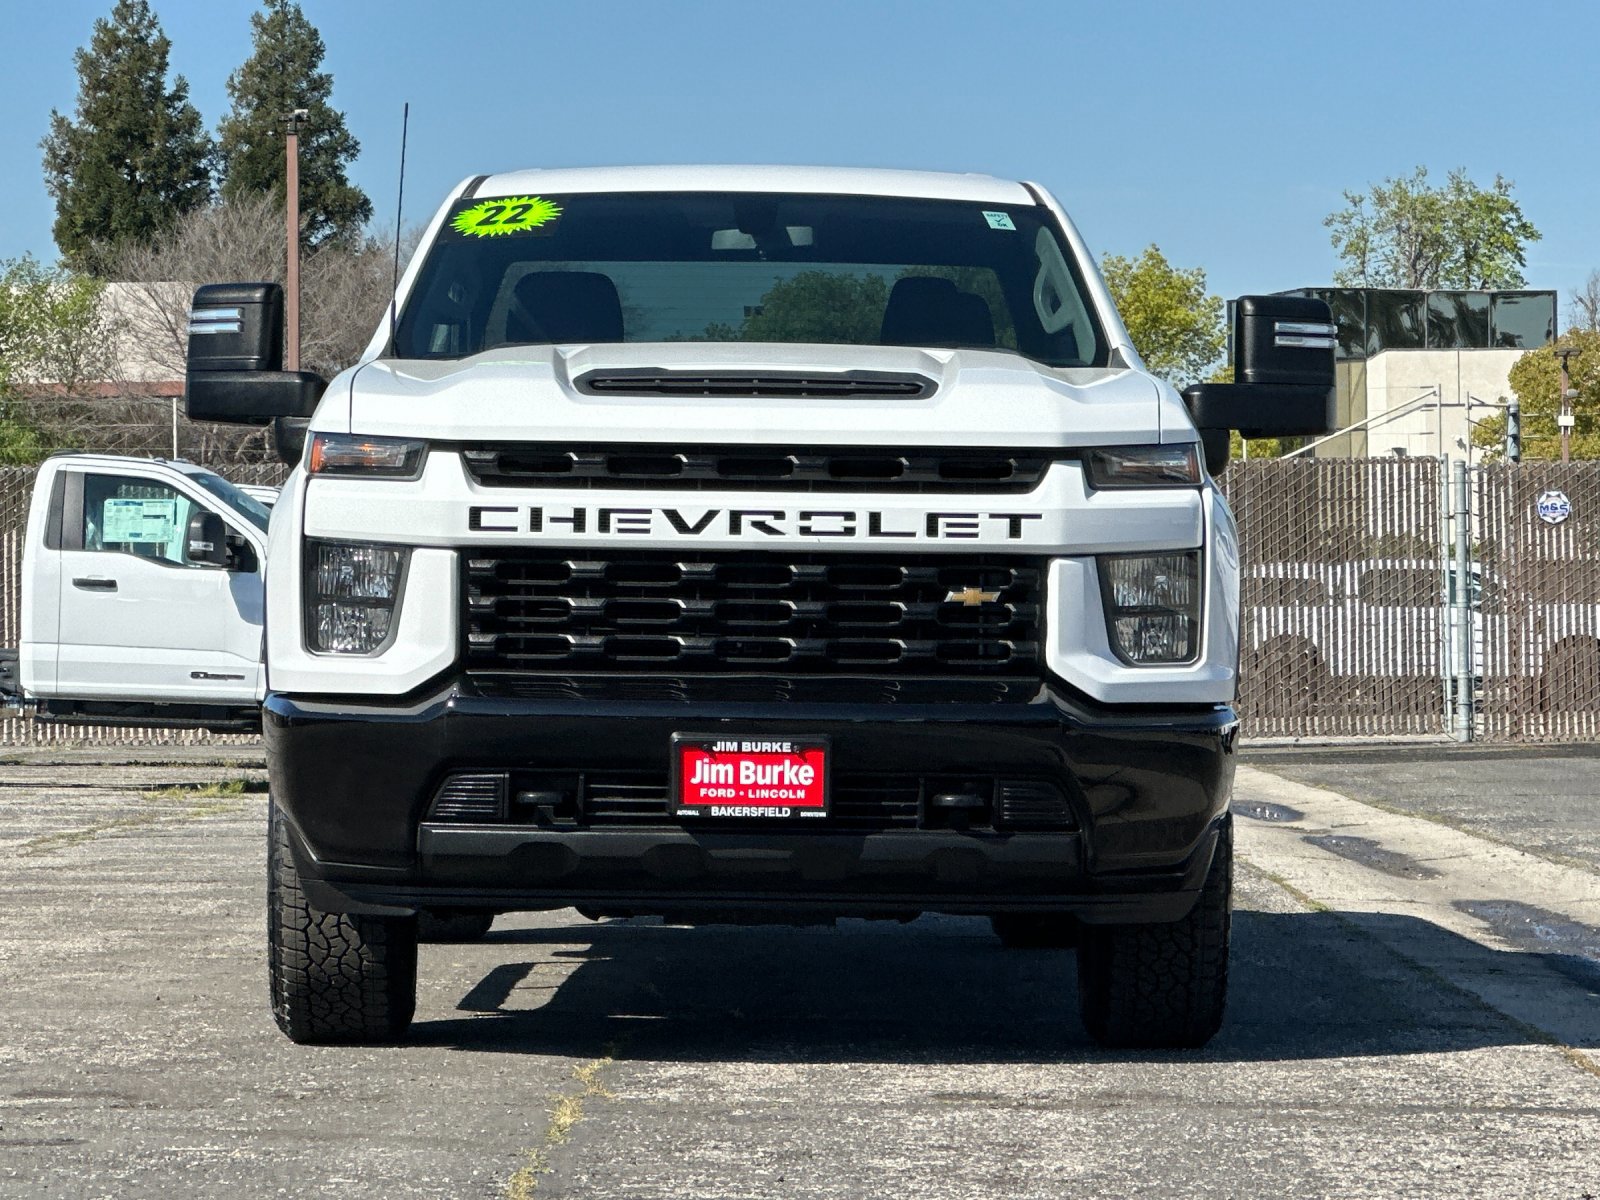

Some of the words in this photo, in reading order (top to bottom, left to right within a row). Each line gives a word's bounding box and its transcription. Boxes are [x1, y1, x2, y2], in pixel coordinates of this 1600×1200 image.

[475, 203, 535, 227] 22
[1539, 503, 1568, 513] M&S
[468, 505, 1043, 539] CHEVROLET
[712, 741, 738, 752] JIM
[741, 741, 792, 753] BURKE
[690, 757, 734, 785] Jim
[739, 759, 815, 786] Burke
[699, 787, 736, 798] FORD
[747, 789, 806, 799] LINCOLN
[711, 806, 791, 818] BAKERSFIELD
